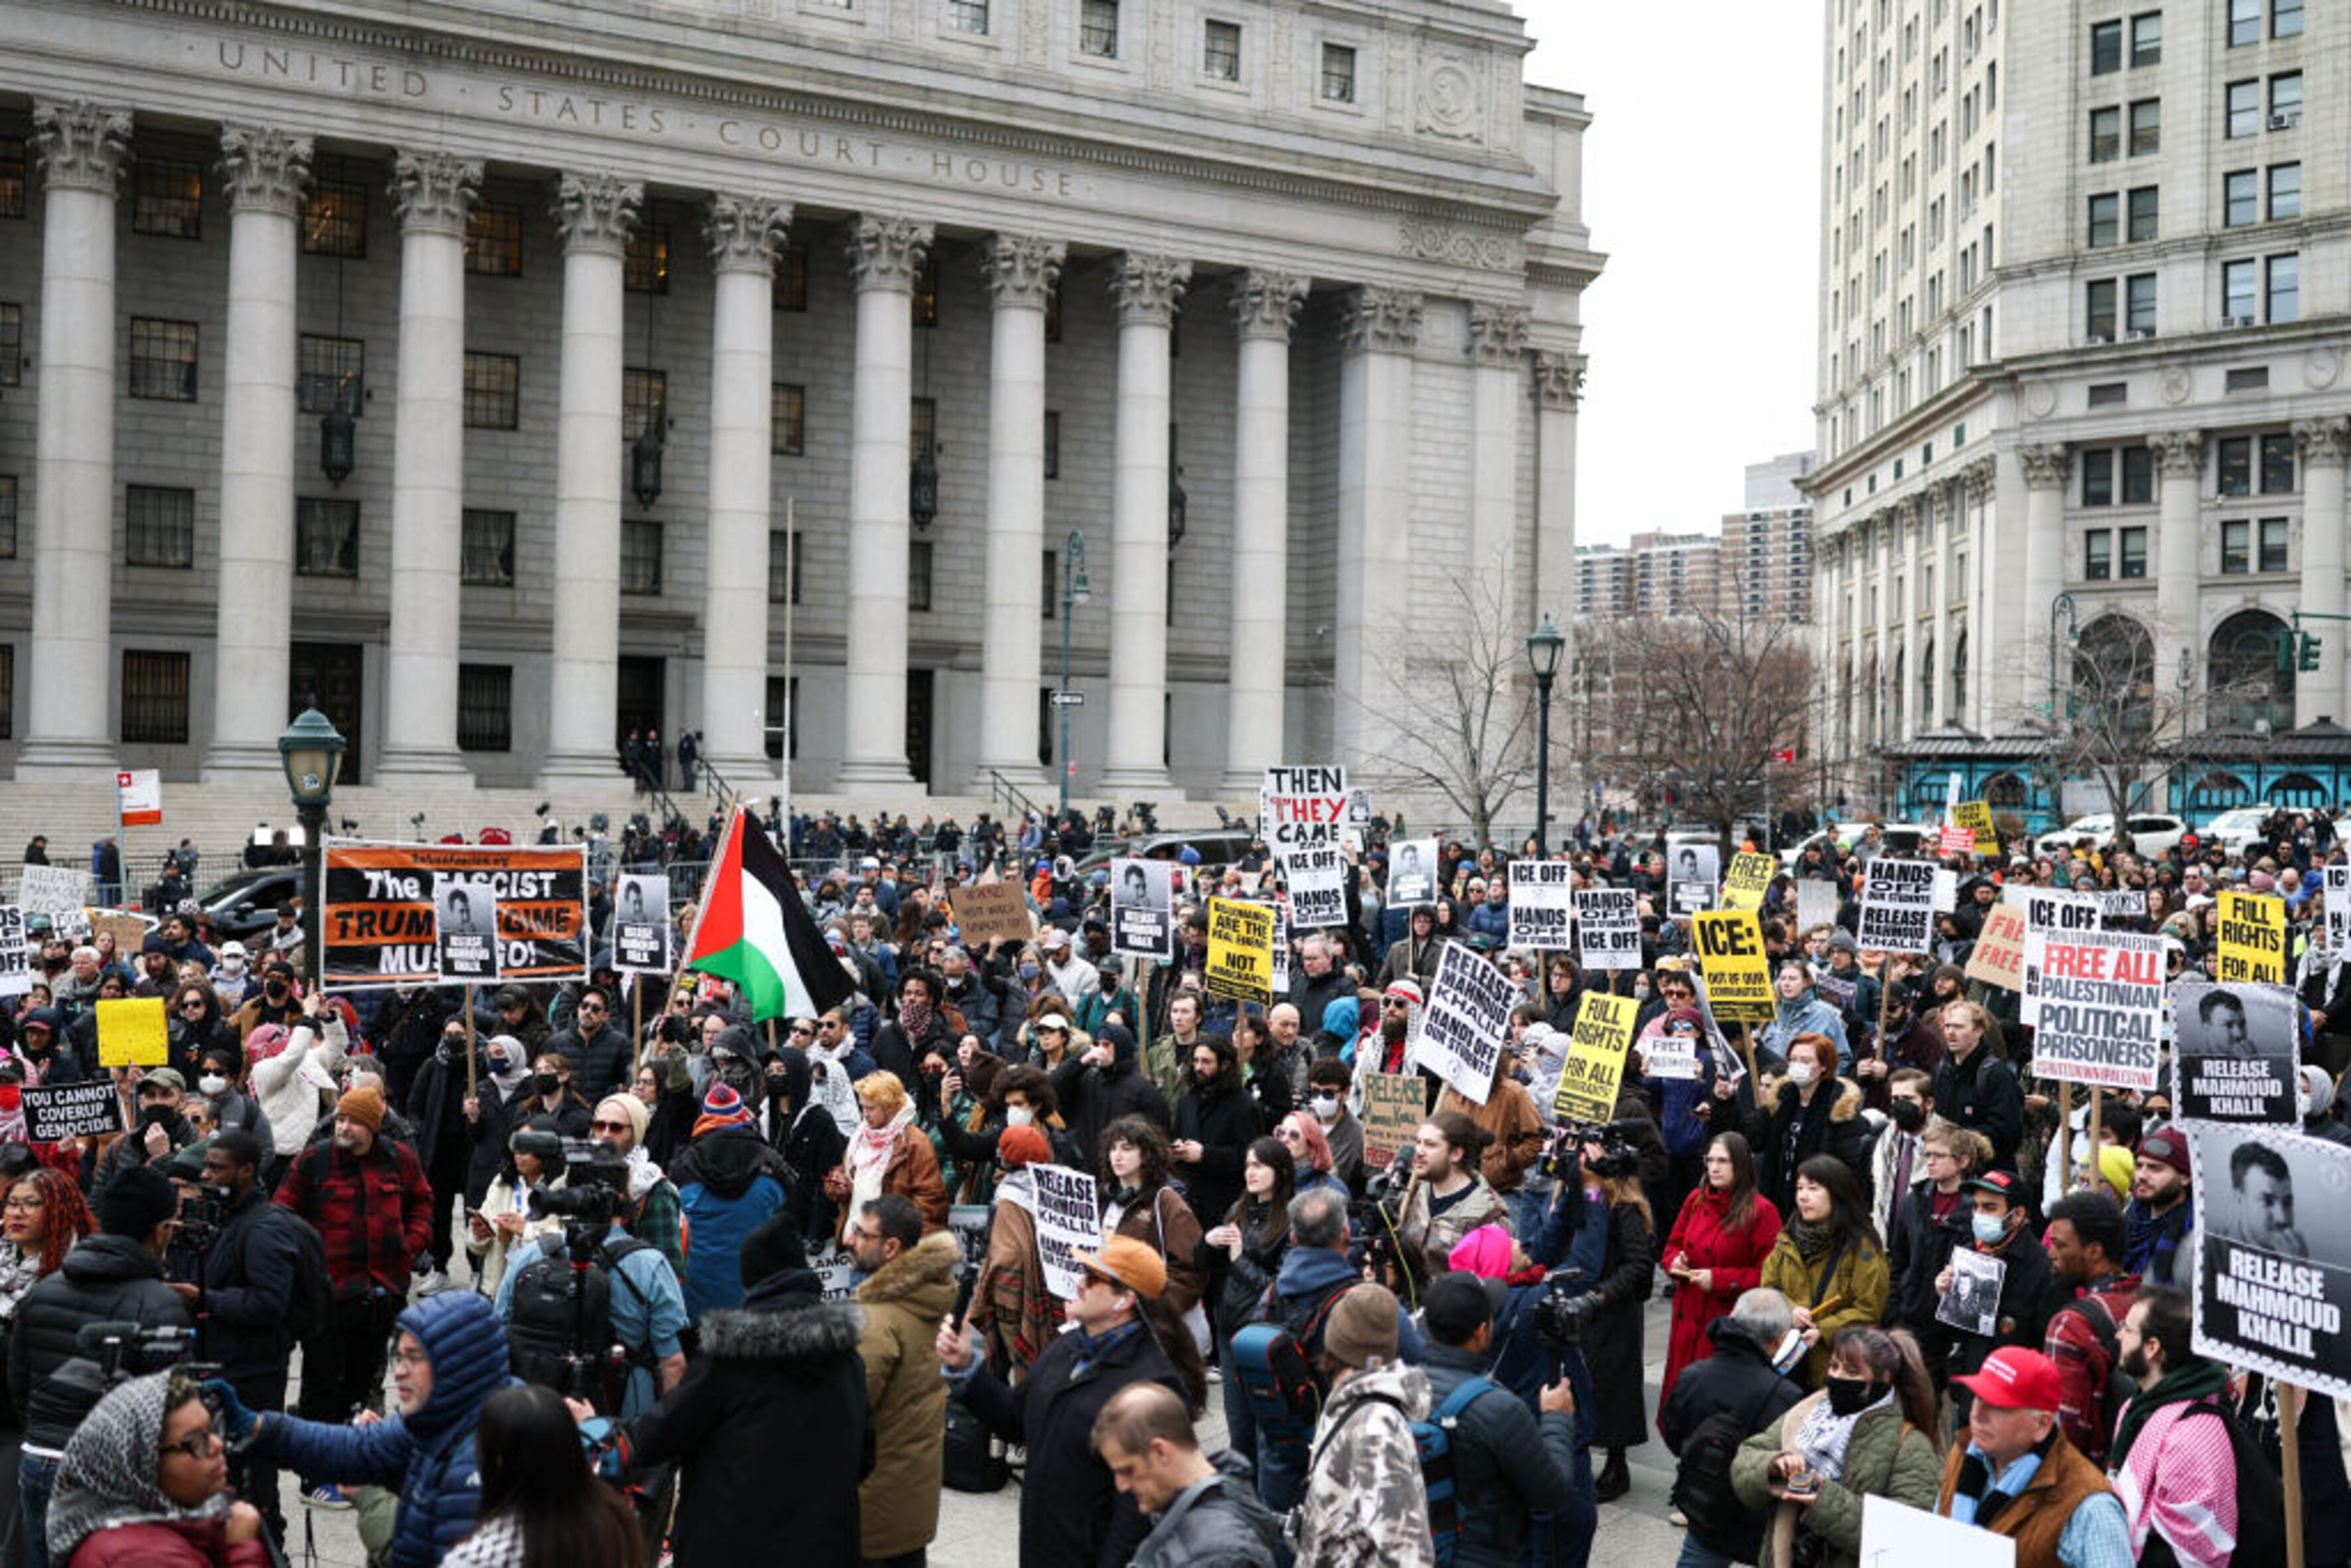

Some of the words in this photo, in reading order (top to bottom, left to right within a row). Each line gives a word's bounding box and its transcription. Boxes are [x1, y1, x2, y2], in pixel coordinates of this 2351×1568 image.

[219, 41, 427, 98] UNITED
[498, 86, 665, 135] STATES
[718, 121, 885, 167] COURT
[932, 153, 1071, 197] HOUSE
[1269, 768, 1342, 793] THEN
[1269, 797, 1346, 823] THEY
[1276, 824, 1340, 842] CAME
[1288, 852, 1309, 870] ICE
[1313, 850, 1336, 867] OFF
[1732, 854, 1771, 880] FREE
[1870, 862, 1934, 884] HANDS
[365, 870, 421, 898] The
[1512, 865, 1535, 882] ICE
[1540, 865, 1567, 882] OFF
[2327, 869, 2348, 886] IC
[1293, 889, 1341, 907] HANDS
[1578, 892, 1634, 909] HANDS
[1870, 881, 1931, 894] OFF
[1888, 893, 1931, 905] STUDENTS
[335, 908, 434, 939] TRUM
[497, 906, 571, 935] GIME
[1296, 905, 1340, 915] OFF
[1514, 907, 1567, 925] HANDS
[1581, 909, 1635, 919] OFF
[1597, 918, 1637, 928] STUDENTS
[1864, 907, 1929, 926] RELEASE
[2029, 899, 2055, 925] ICE
[2061, 904, 2097, 929] OFF
[2233, 897, 2271, 925] FULL
[1216, 914, 1240, 933] ARE
[1244, 920, 1268, 939] THE
[1514, 925, 1565, 935] OFF
[1698, 918, 1757, 956] ICE:
[1989, 914, 2024, 941] FRE
[2222, 920, 2280, 952] RIGHTS
[1512, 935, 1527, 944] OUR
[1529, 935, 1567, 946] STUDENTS
[1582, 932, 1607, 949] ICE
[1611, 931, 1638, 949] OFF
[1861, 936, 1924, 949] KHALIL
[380, 945, 441, 974] MU
[497, 940, 536, 967] GO!
[1226, 952, 1257, 971] NOT
[1273, 950, 1286, 969] FF
[1977, 943, 2022, 973] FREE
[2044, 943, 2106, 980] FREE
[2112, 949, 2161, 986] ALL
[2222, 955, 2248, 979] FOR
[2251, 963, 2277, 983] ALL
[1444, 945, 1516, 1008] RELEASE
[1440, 968, 1507, 1026] MAHMOUD
[2041, 977, 2160, 1009] PALESTINIAN
[1435, 984, 1500, 1041] KHALIL
[1586, 998, 1620, 1026] FULL
[2040, 1002, 2156, 1043] POLITICAL
[1429, 1005, 1475, 1048] HANDS
[1473, 1037, 1497, 1061] OFF
[1575, 1020, 1626, 1052] RIGHTS
[1425, 1022, 1447, 1046] OUR
[1447, 1036, 1493, 1078] STUDENTS
[1652, 1040, 1687, 1053] FREE
[2036, 1032, 2156, 1069] PRISONERS
[1565, 1056, 1587, 1078] FOR
[1588, 1062, 1615, 1087] ALL
[2202, 1059, 2271, 1079] RELEASE
[23, 1091, 51, 1107] YOU
[54, 1085, 116, 1105] CANNOT
[1365, 1073, 1424, 1105] RELEASE
[2192, 1078, 2283, 1097] MAHMOUD
[38, 1103, 104, 1121] COVERUP
[2210, 1097, 2267, 1115] KHALIL
[35, 1115, 115, 1138] GENOCIDE
[1033, 1167, 1094, 1203] RELEASE
[1038, 1190, 1095, 1222] MAHMOUD
[1038, 1208, 1097, 1236] KHALIL
[1040, 1232, 1074, 1259] HANDS
[2229, 1247, 2324, 1301] RELEASE
[2216, 1273, 2340, 1336] MAHMOUD
[2237, 1307, 2316, 1360] KHALIL
